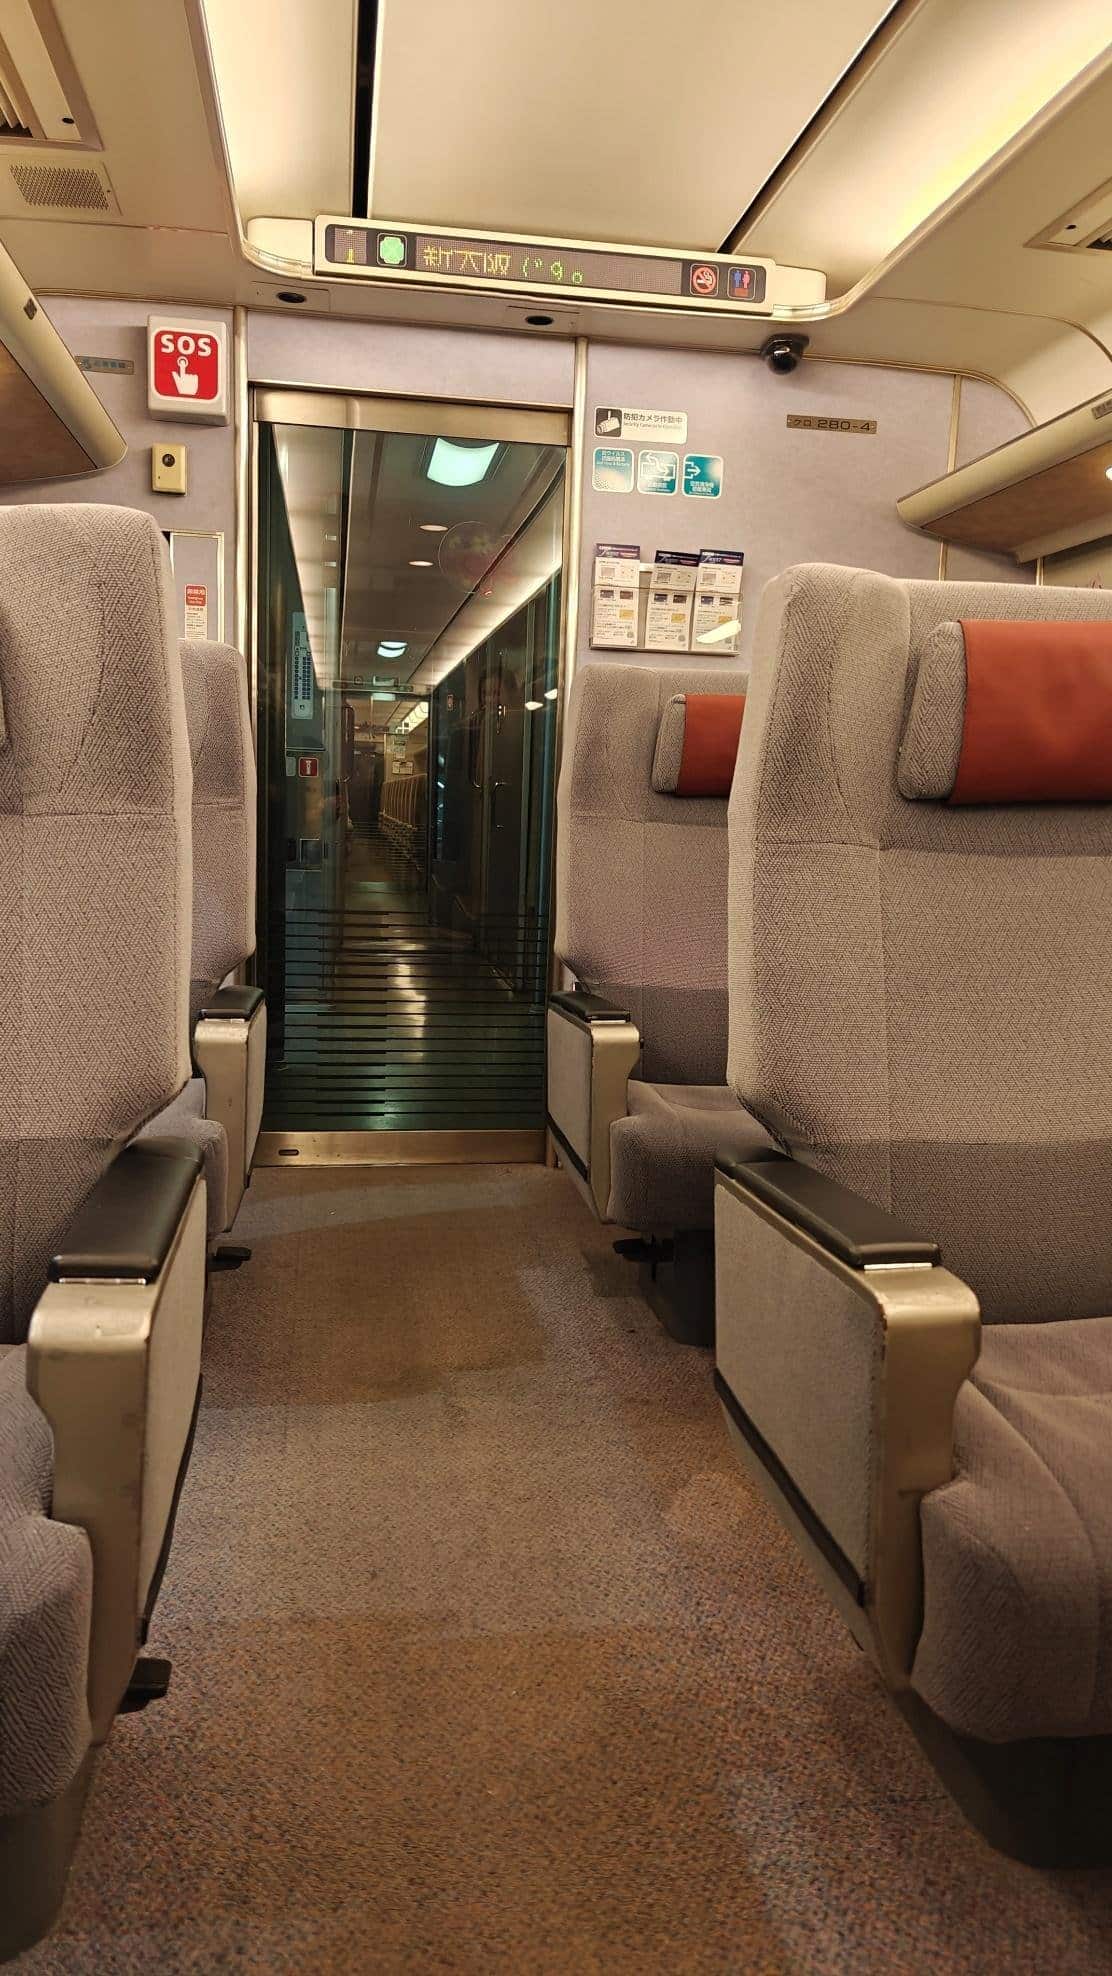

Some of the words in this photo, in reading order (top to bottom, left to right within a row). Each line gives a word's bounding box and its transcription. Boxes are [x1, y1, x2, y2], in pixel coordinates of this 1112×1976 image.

[160, 334, 212, 356] SOS
[623, 412, 683, 425] 防犯カメラ作動中
[817, 419, 870, 431] 280-4
